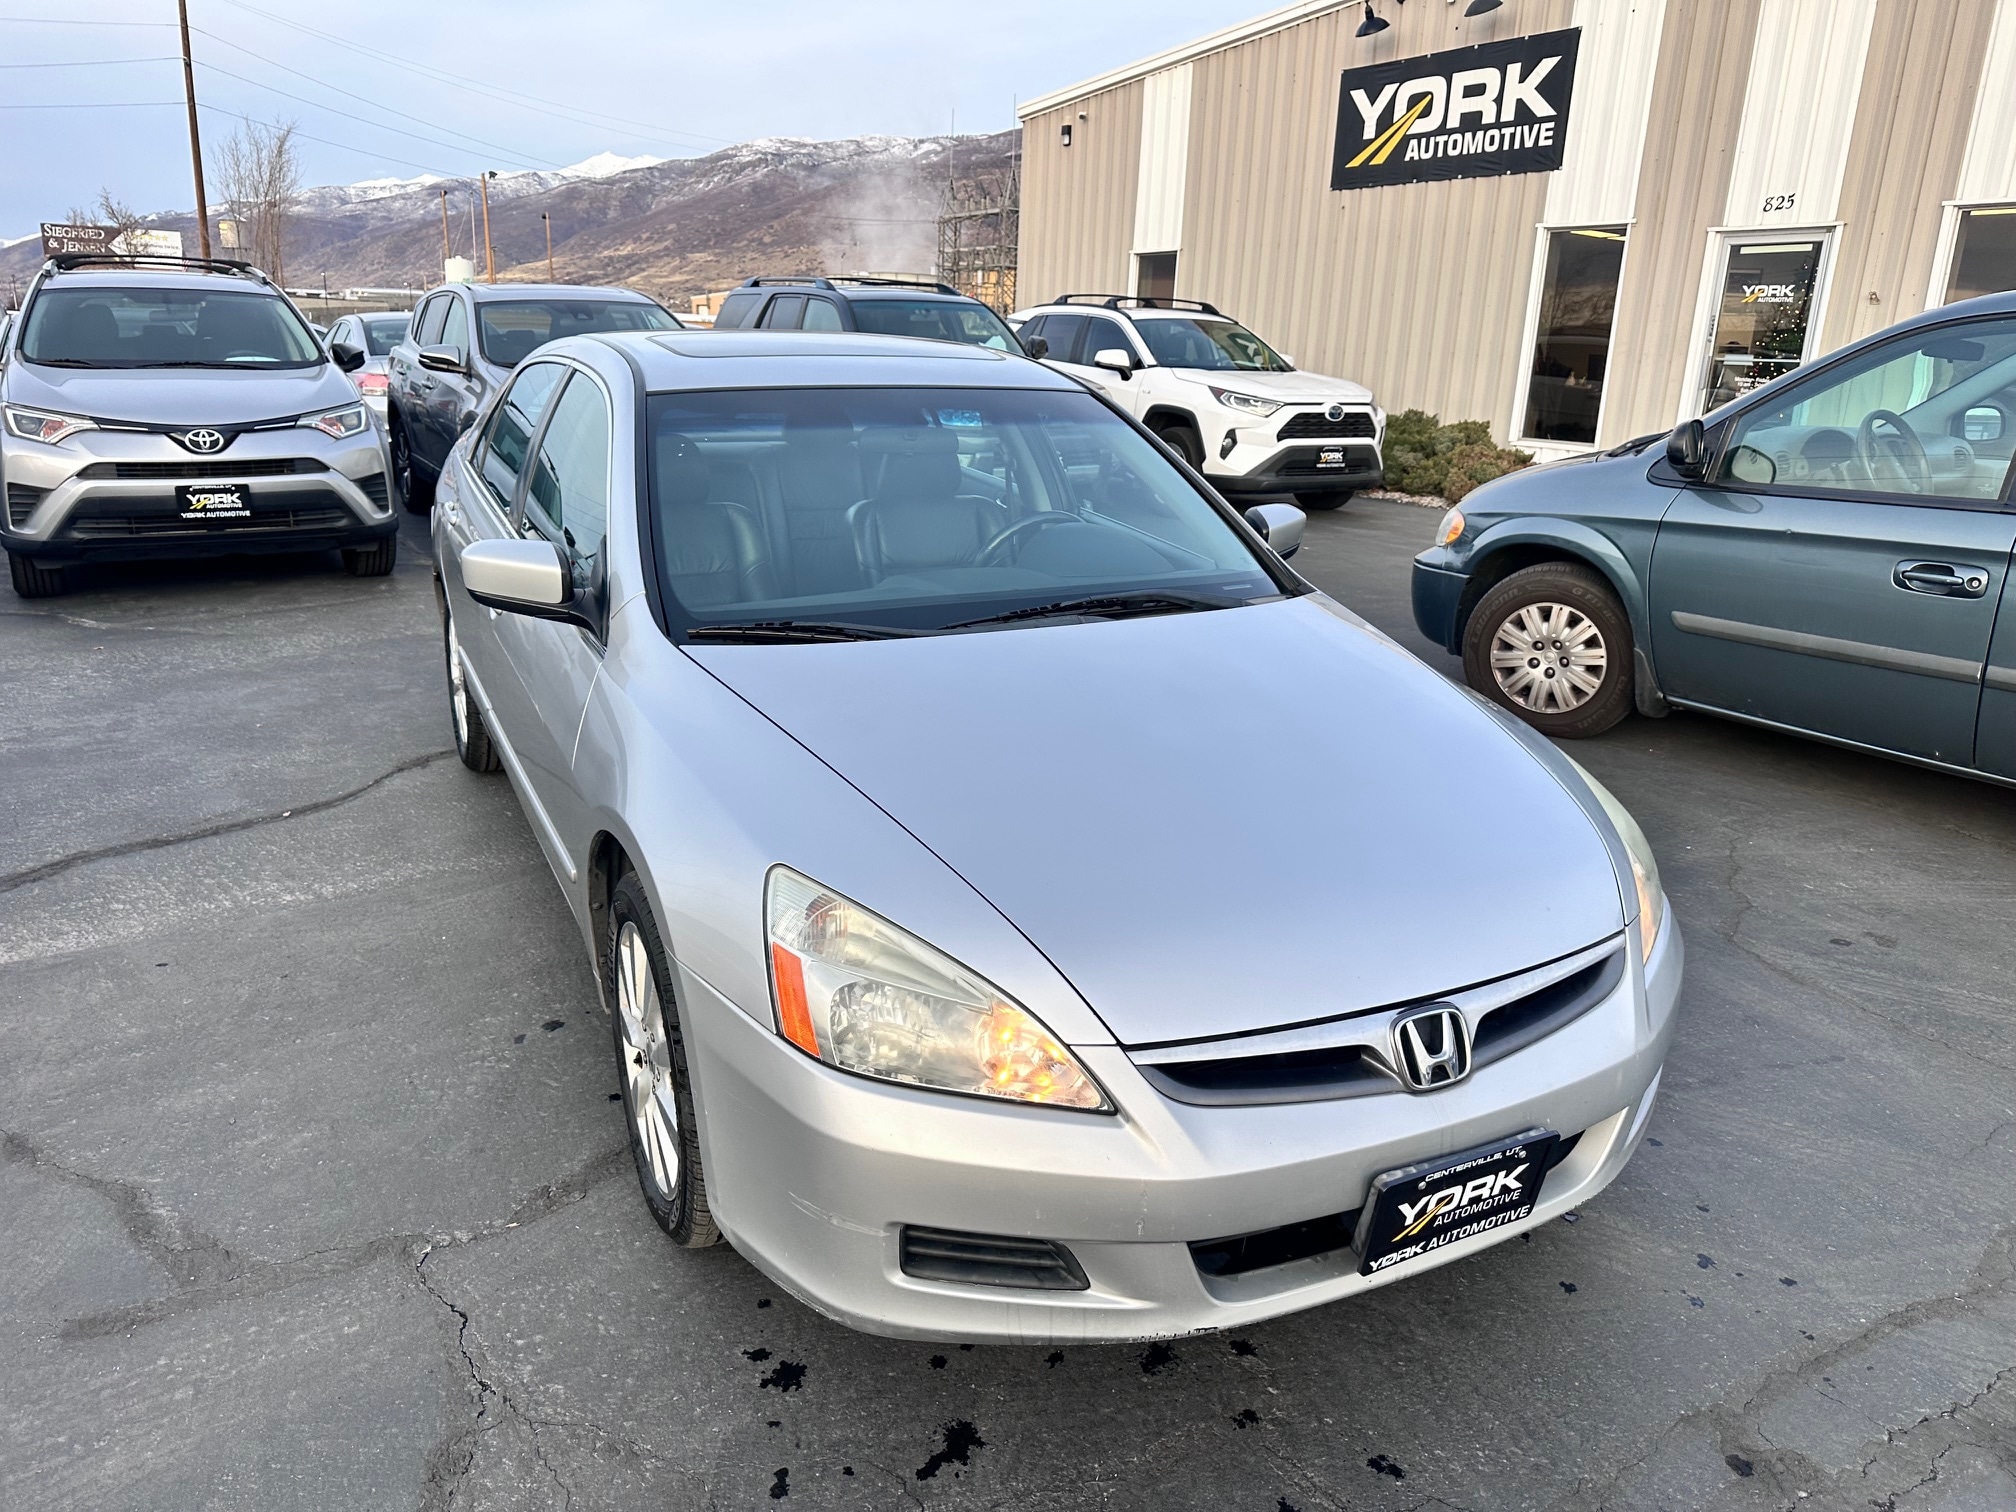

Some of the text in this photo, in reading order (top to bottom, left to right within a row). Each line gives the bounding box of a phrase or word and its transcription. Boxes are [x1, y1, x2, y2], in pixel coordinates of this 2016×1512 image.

[1350, 55, 1563, 140] YORK
[1404, 121, 1555, 162] AUTOMOTIVE
[1762, 193, 1796, 213] 825
[48, 238, 60, 249] &
[1742, 284, 1796, 297] YORK
[186, 493, 242, 505] YORK
[206, 510, 251, 518] AUTOMOTIVE
[1425, 1153, 1503, 1182] CENTERVILLE,
[1398, 1163, 1530, 1227] YORK
[1433, 1188, 1522, 1228] AUTOMOTIVE
[1369, 1204, 1531, 1272] YORK AUTOMOTIVE
